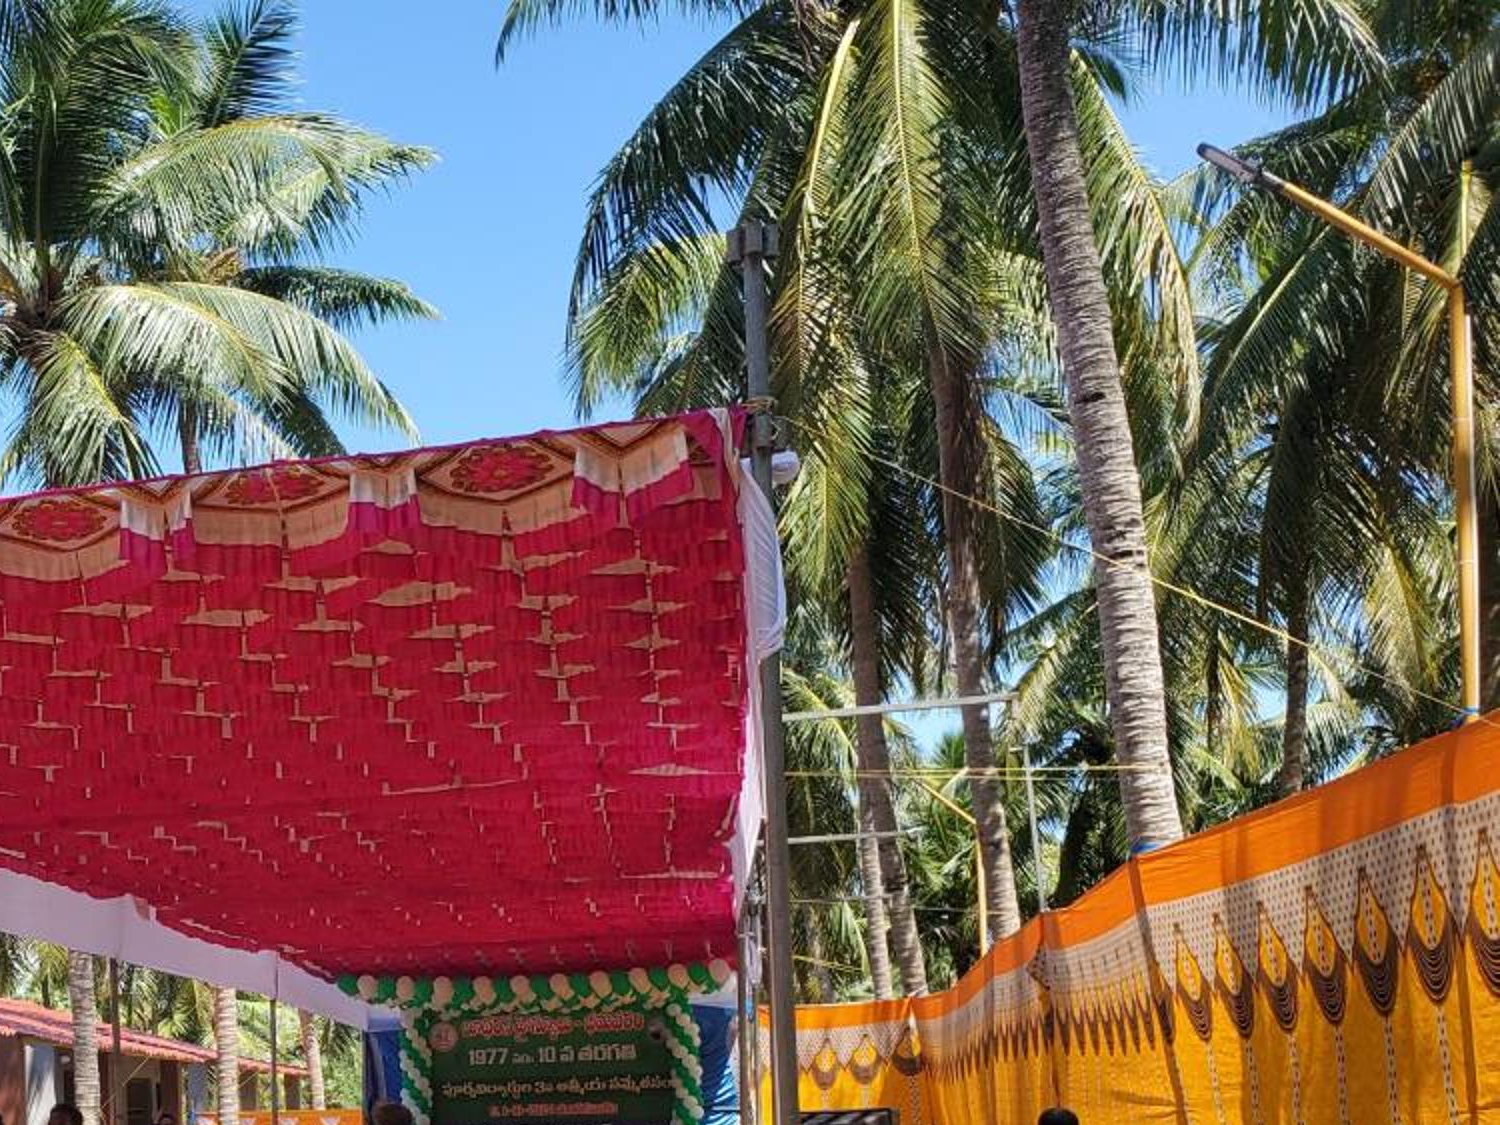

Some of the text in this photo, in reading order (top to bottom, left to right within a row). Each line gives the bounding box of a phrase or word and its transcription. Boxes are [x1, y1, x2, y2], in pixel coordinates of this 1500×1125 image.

[468, 1047, 509, 1066] 1977
[538, 1046, 557, 1063] 10
[578, 1043, 638, 1061] తరగతి
